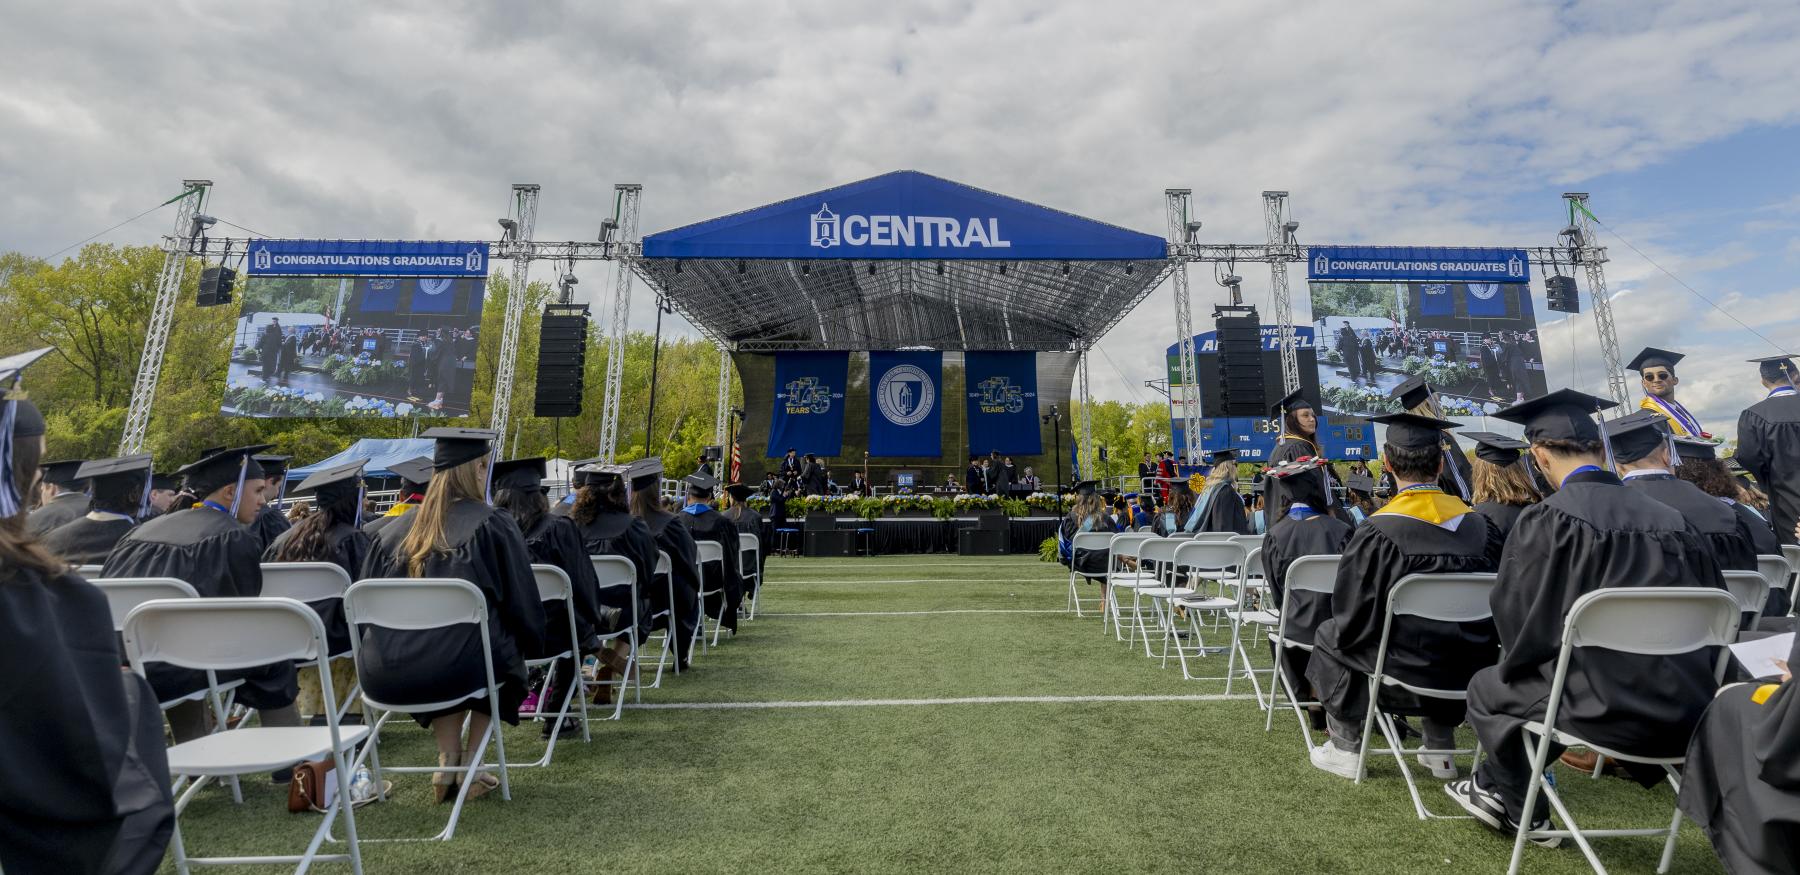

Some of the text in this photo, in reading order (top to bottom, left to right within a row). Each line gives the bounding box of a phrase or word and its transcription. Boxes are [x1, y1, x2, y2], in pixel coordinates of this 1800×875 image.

[843, 214, 1011, 248] CENTRAL
[273, 255, 464, 267] CONGRATULATIONS GRADUATES
[1331, 261, 1507, 272] CONGRATULATIONS GRADUATES
[1270, 335, 1316, 349] FEL
[1251, 449, 1261, 457] GO
[1345, 447, 1361, 456] QTR
